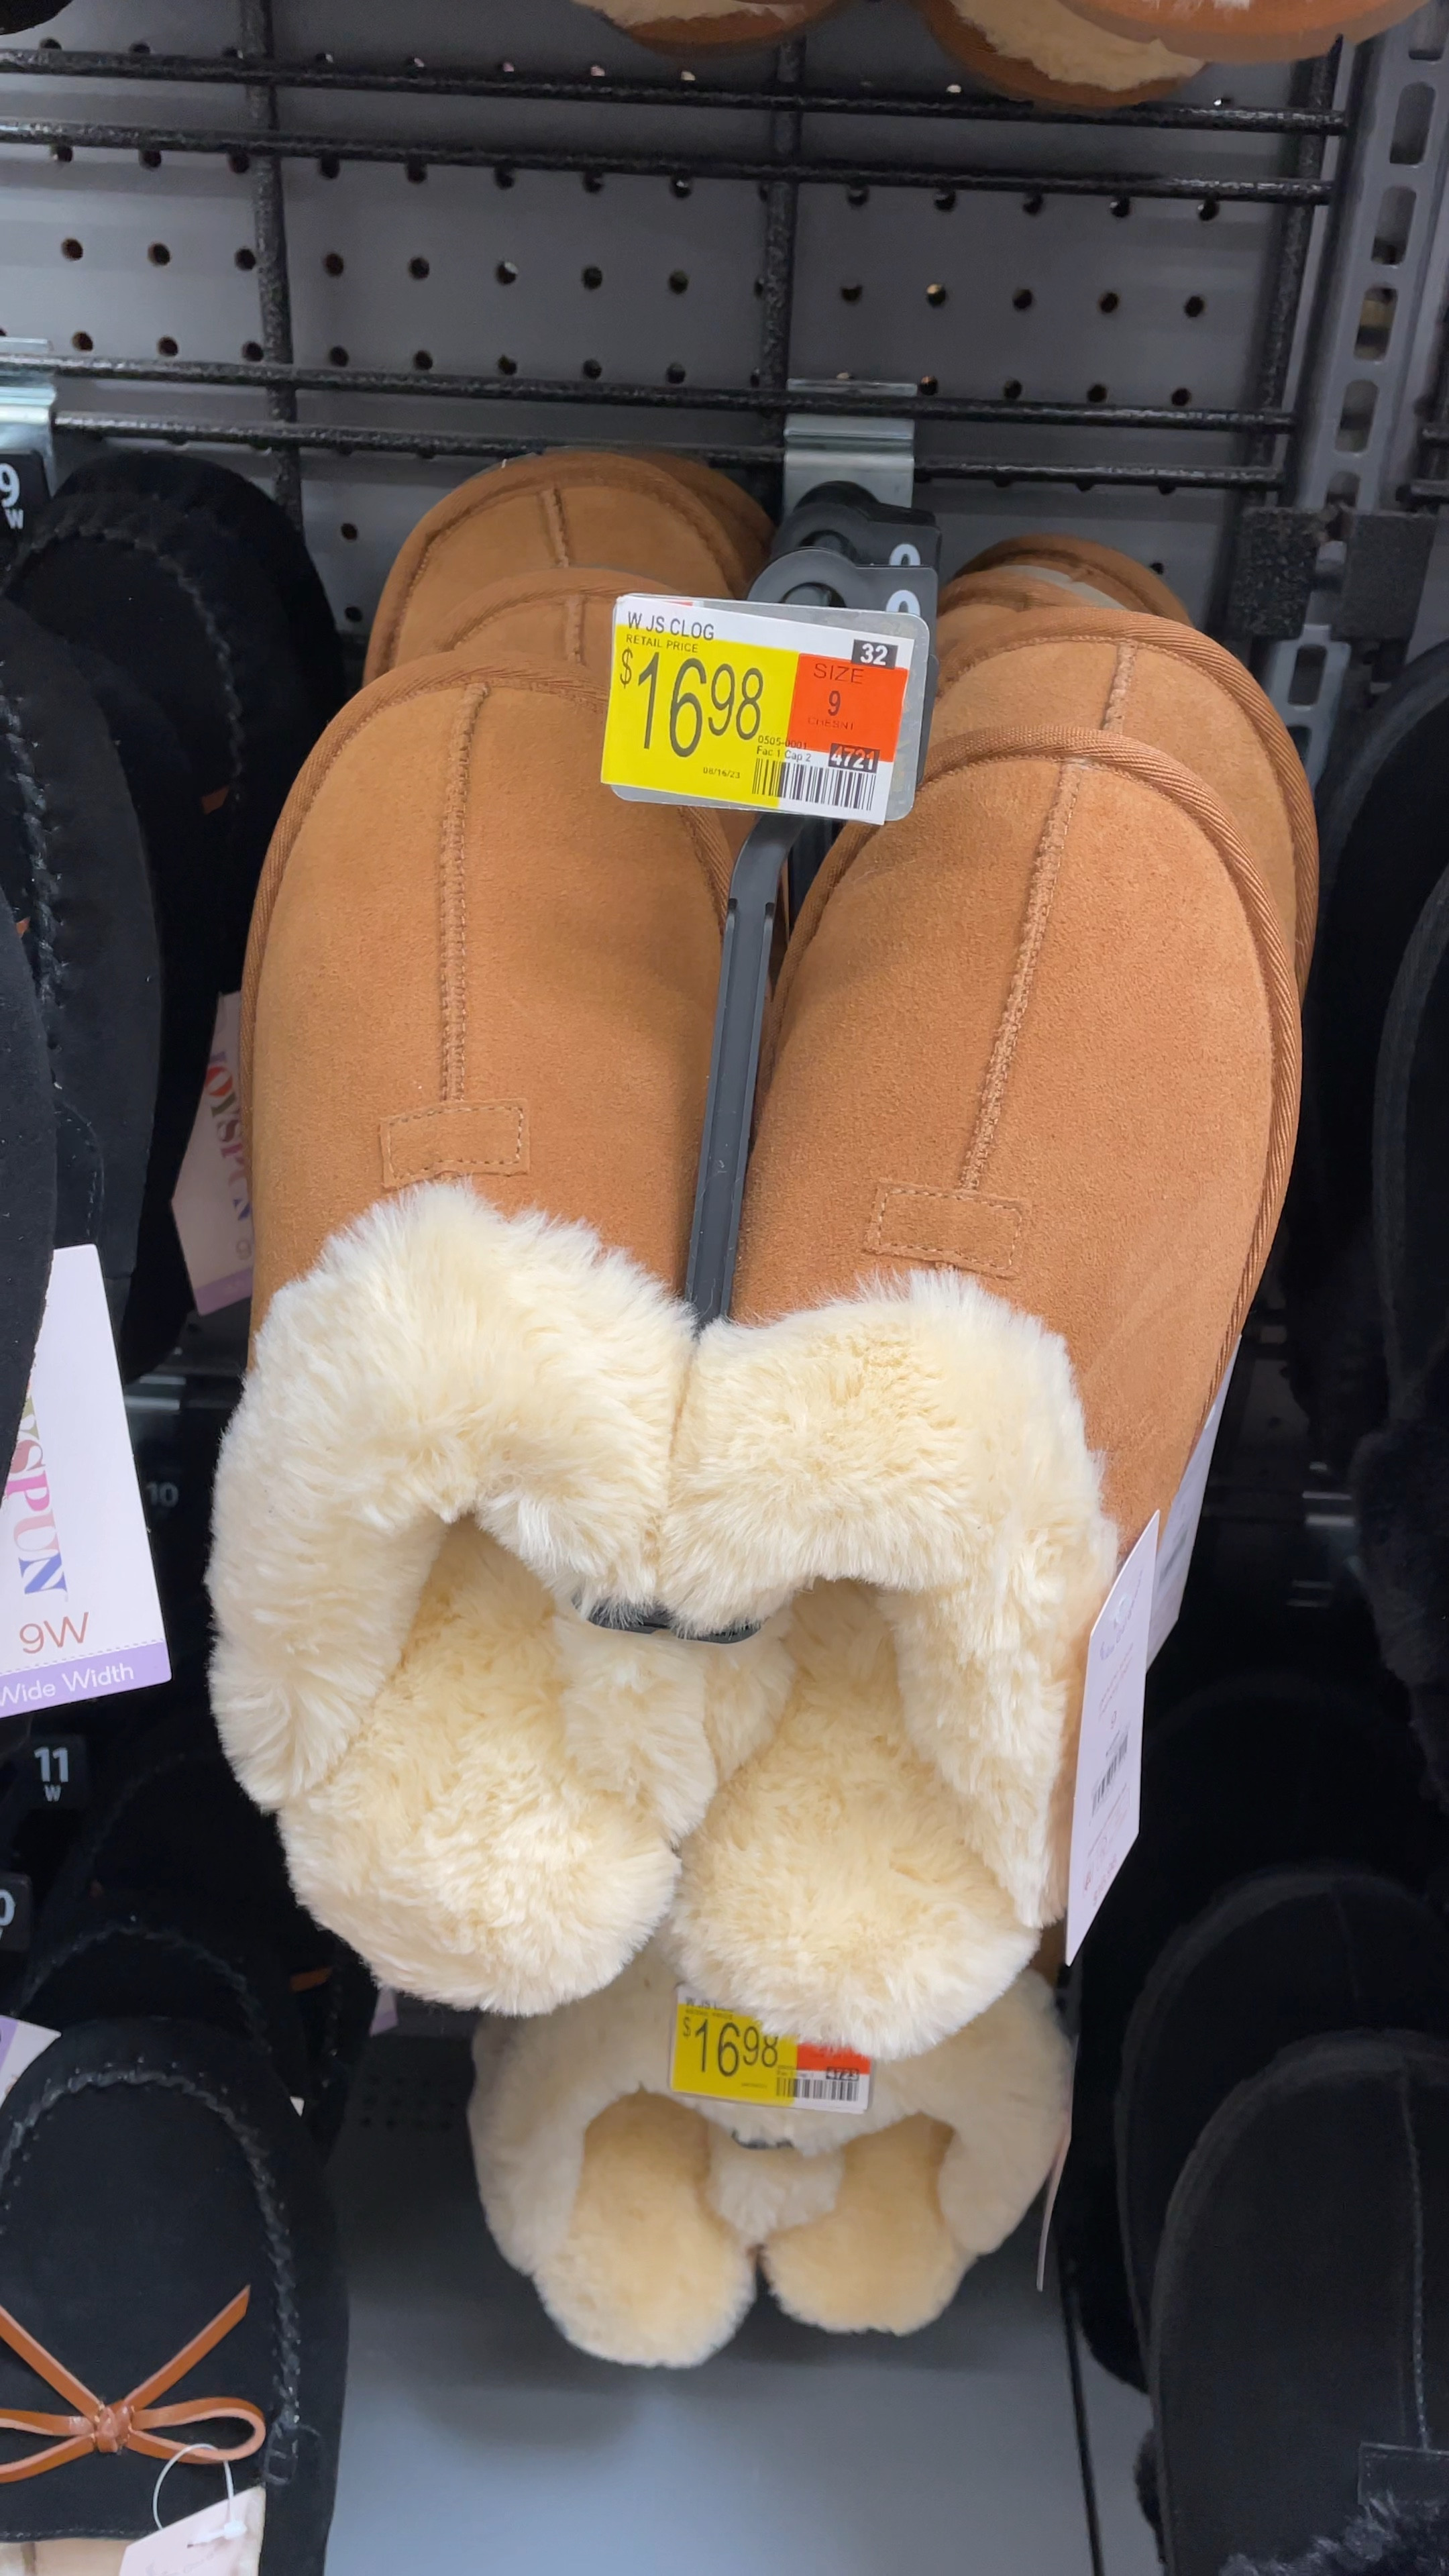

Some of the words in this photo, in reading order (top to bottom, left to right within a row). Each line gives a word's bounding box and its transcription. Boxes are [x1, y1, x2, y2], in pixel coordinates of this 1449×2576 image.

[0, 463, 20, 508] 9
[628, 610, 643, 630] W
[645, 614, 665, 634] JS
[669, 617, 715, 641] CLOG
[626, 633, 663, 648] RETAIL
[666, 639, 699, 653] PRICE
[859, 643, 888, 666] 32
[813, 662, 865, 684] SIZE
[827, 690, 841, 716] 9
[757, 745, 773, 757] Fac
[777, 749, 781, 757] 1
[784, 749, 803, 762] Cap
[805, 753, 812, 762] 2
[830, 745, 875, 771] 4721
[19, 1611, 89, 1654] 9W
[0, 1680, 56, 1706] Wide
[62, 1662, 134, 1692] Width
[34, 1747, 68, 1782] 11
